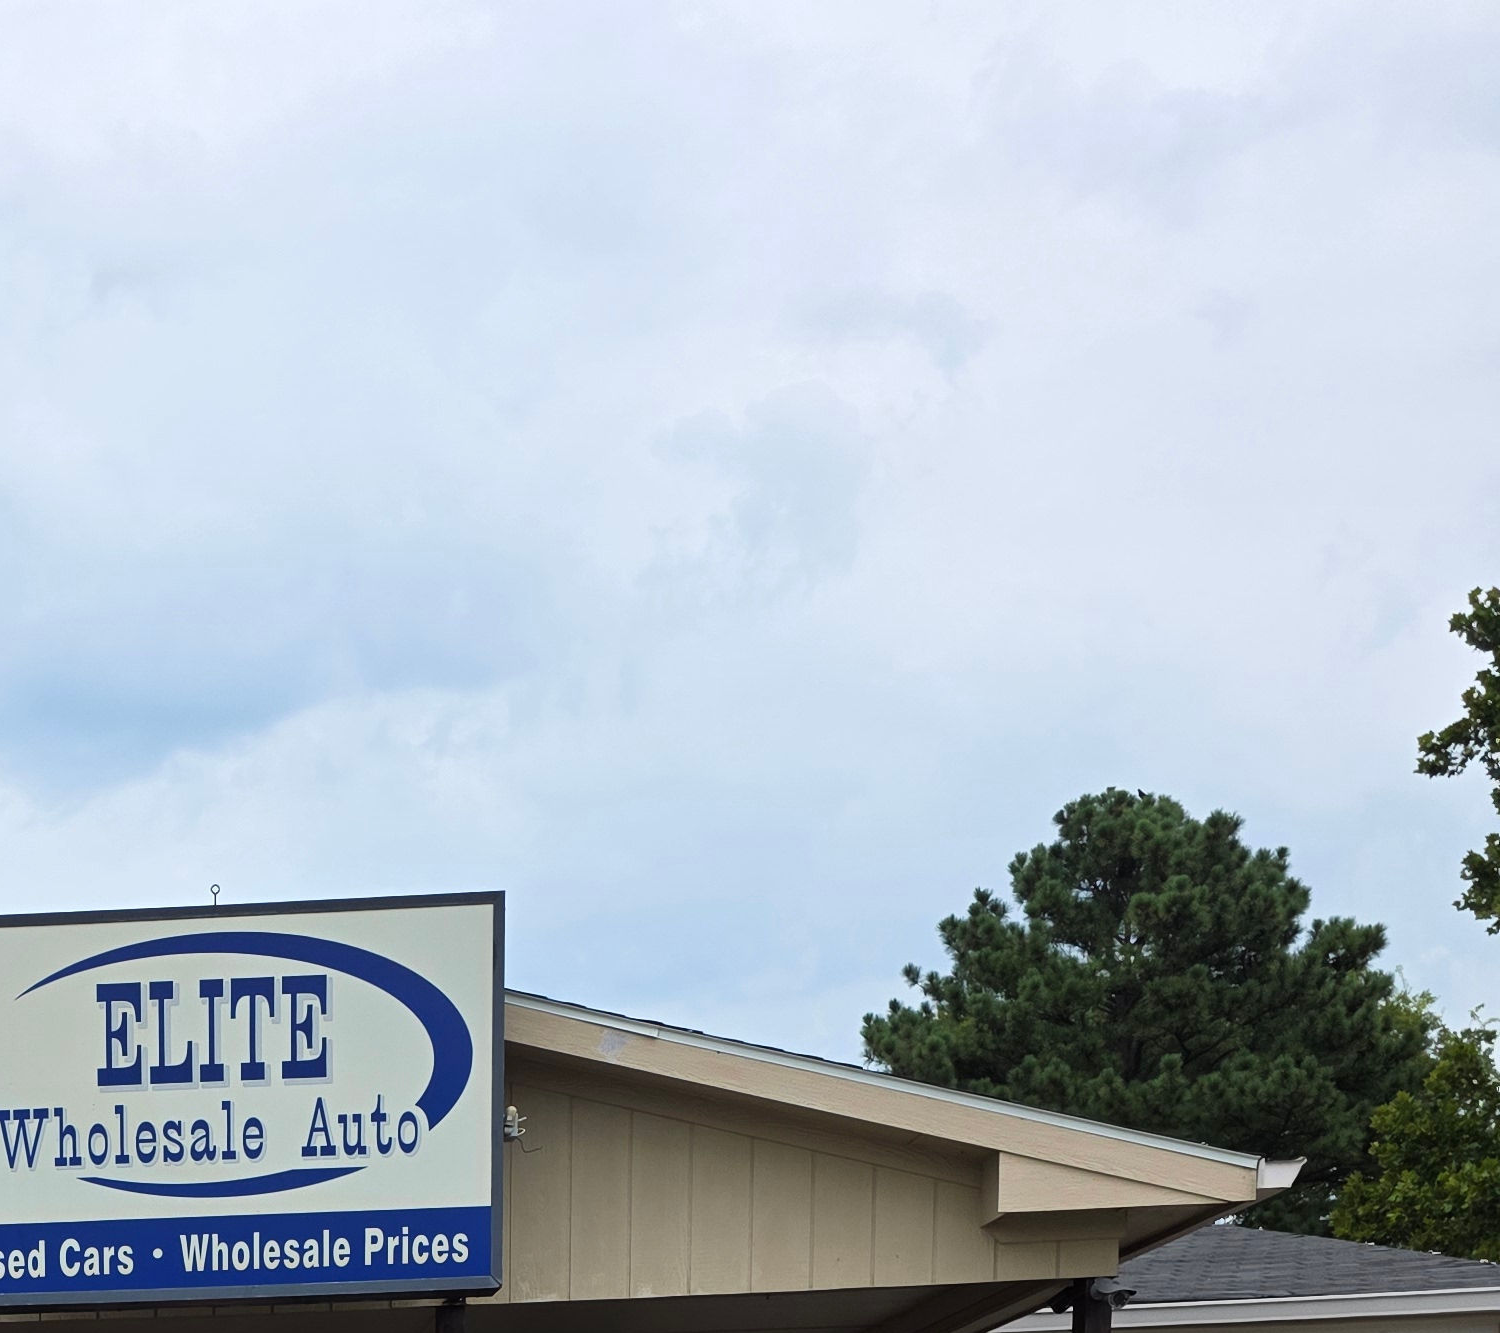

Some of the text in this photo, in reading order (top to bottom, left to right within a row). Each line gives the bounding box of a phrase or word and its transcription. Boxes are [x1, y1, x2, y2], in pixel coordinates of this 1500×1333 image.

[96, 975, 329, 1088] ELITE
[301, 1094, 420, 1158] Auto
[59, 1237, 134, 1277] Cars
[180, 1228, 351, 1272] Wholesale
[364, 1226, 469, 1266] Prices
